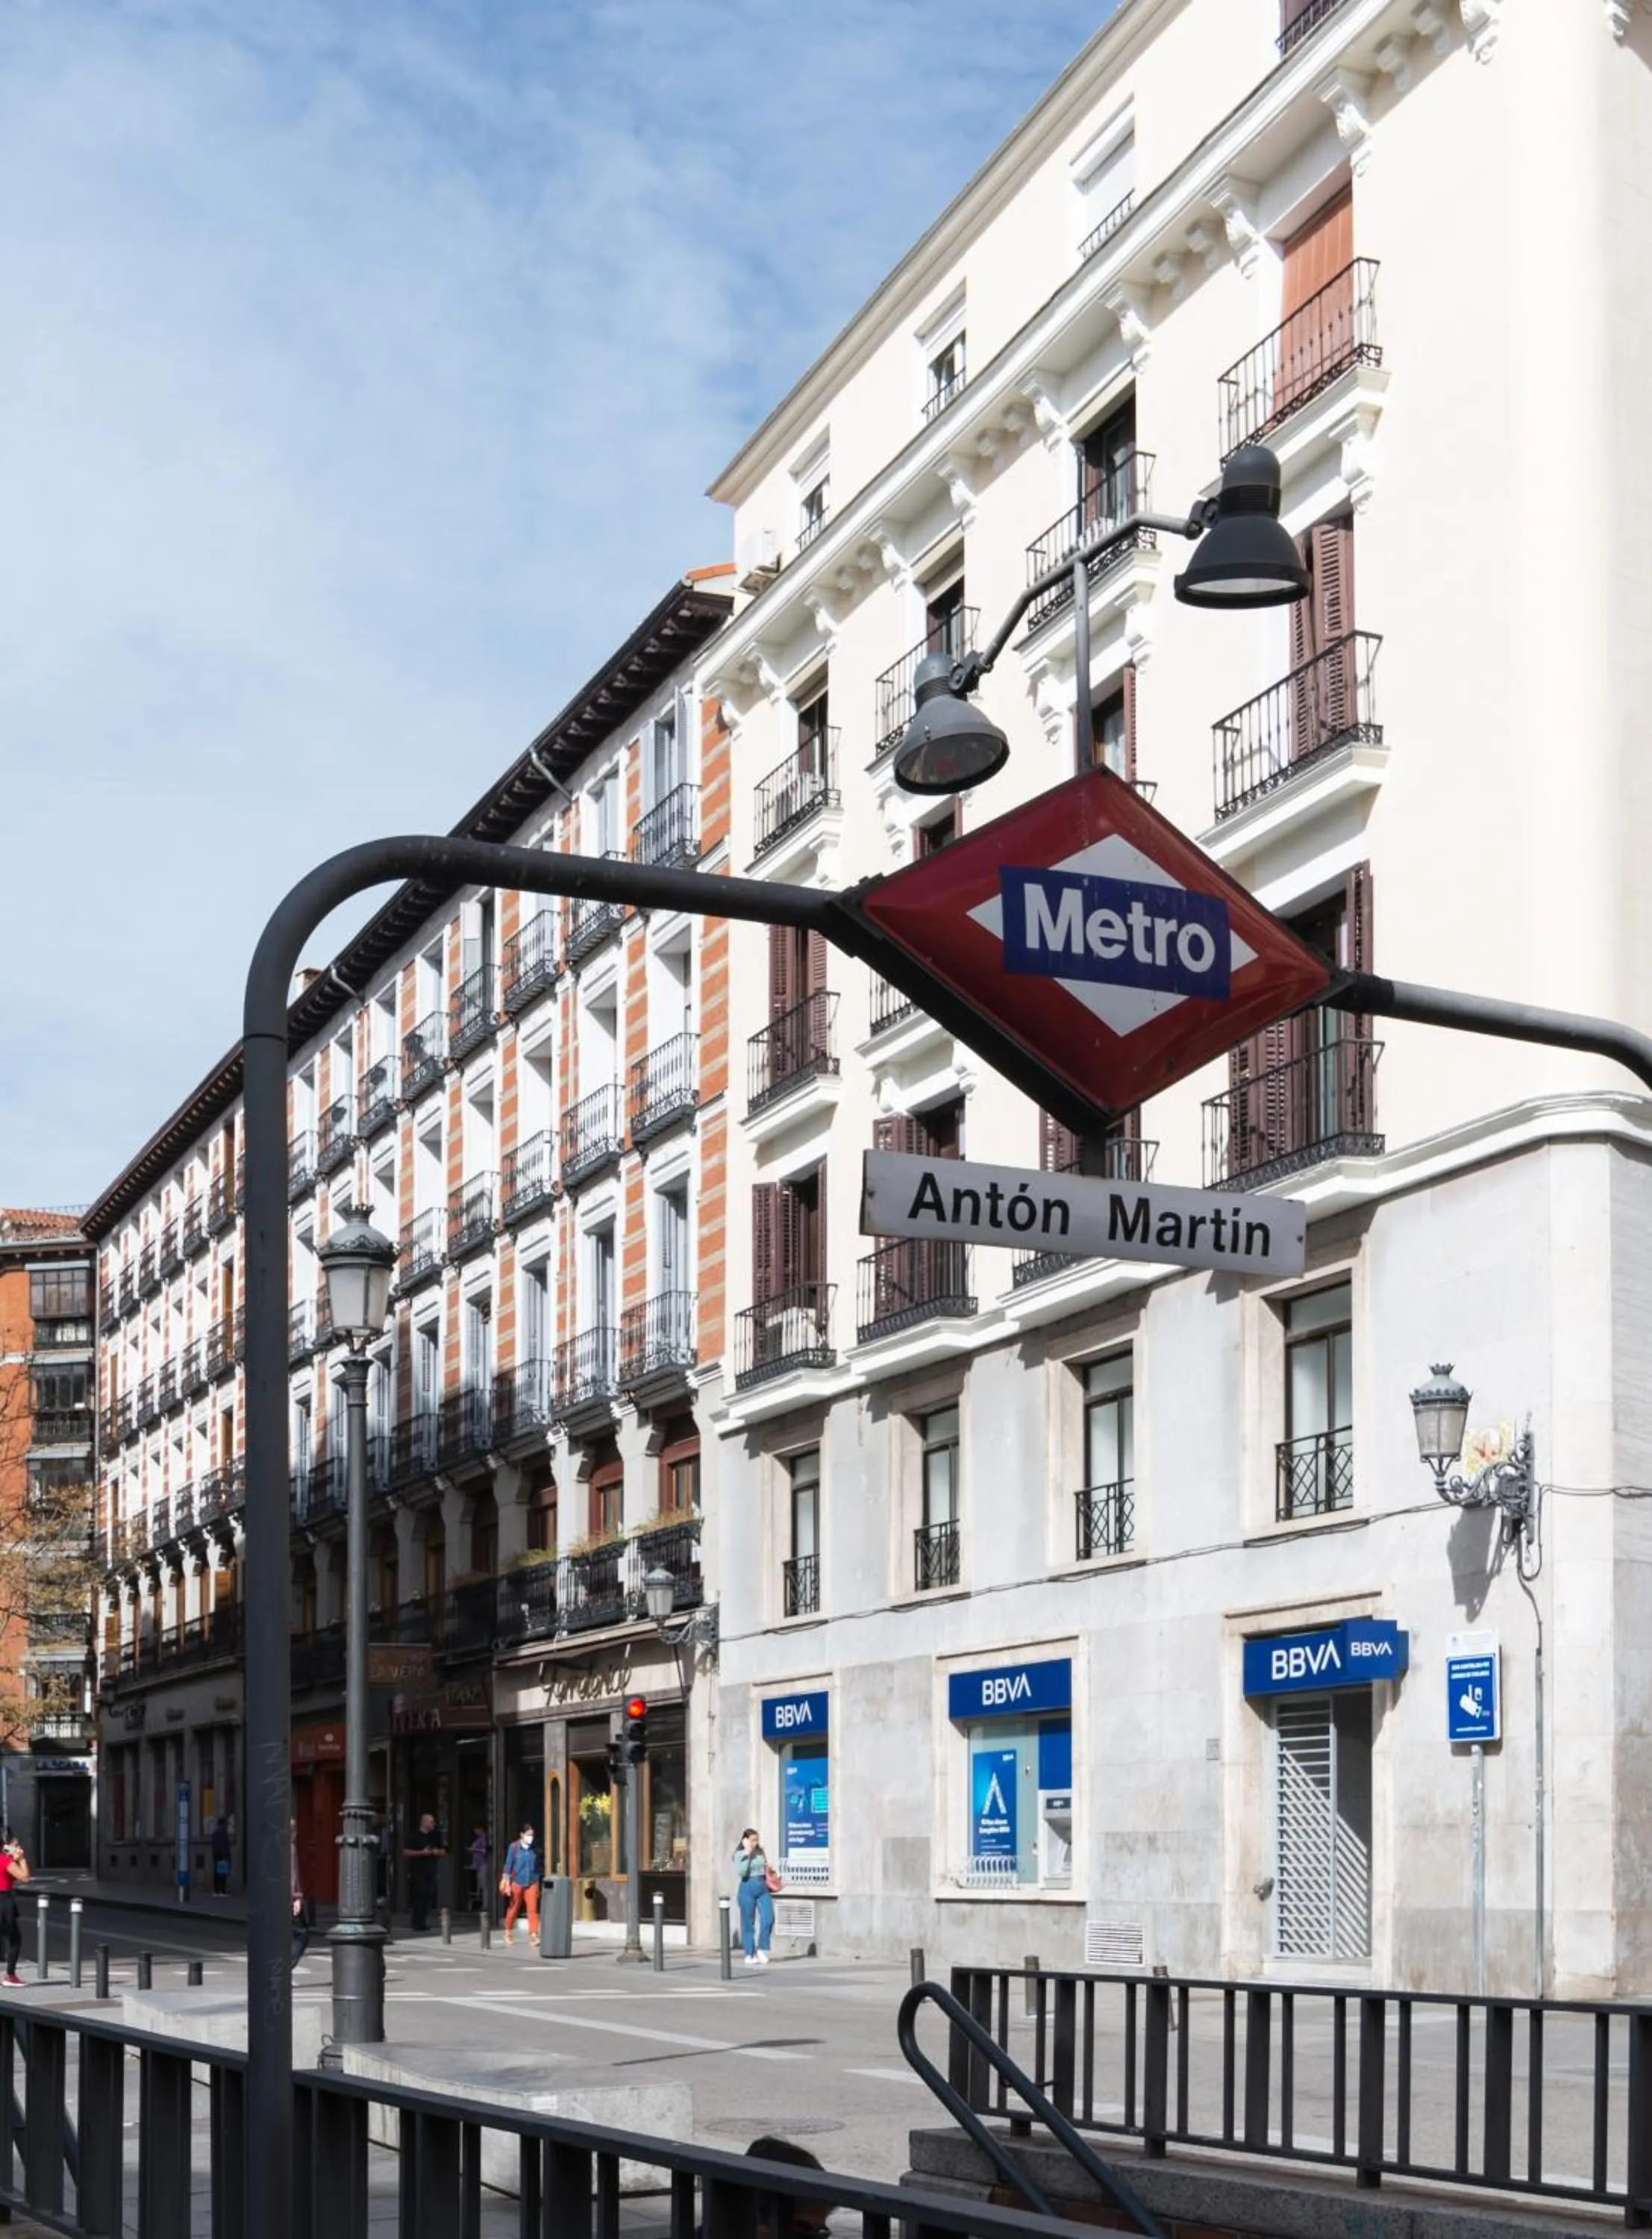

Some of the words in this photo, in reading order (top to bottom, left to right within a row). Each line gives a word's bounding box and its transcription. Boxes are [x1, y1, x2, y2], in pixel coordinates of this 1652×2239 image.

[1024, 883, 1215, 972] Metro
[907, 1172, 1070, 1237] Antón
[1107, 1193, 1271, 1258] Martín
[1271, 1640, 1341, 1680] BBVA
[1351, 1641, 1392, 1657] BBVA
[982, 1673, 1031, 1705] BBVA
[775, 1700, 813, 1729] BBVA
